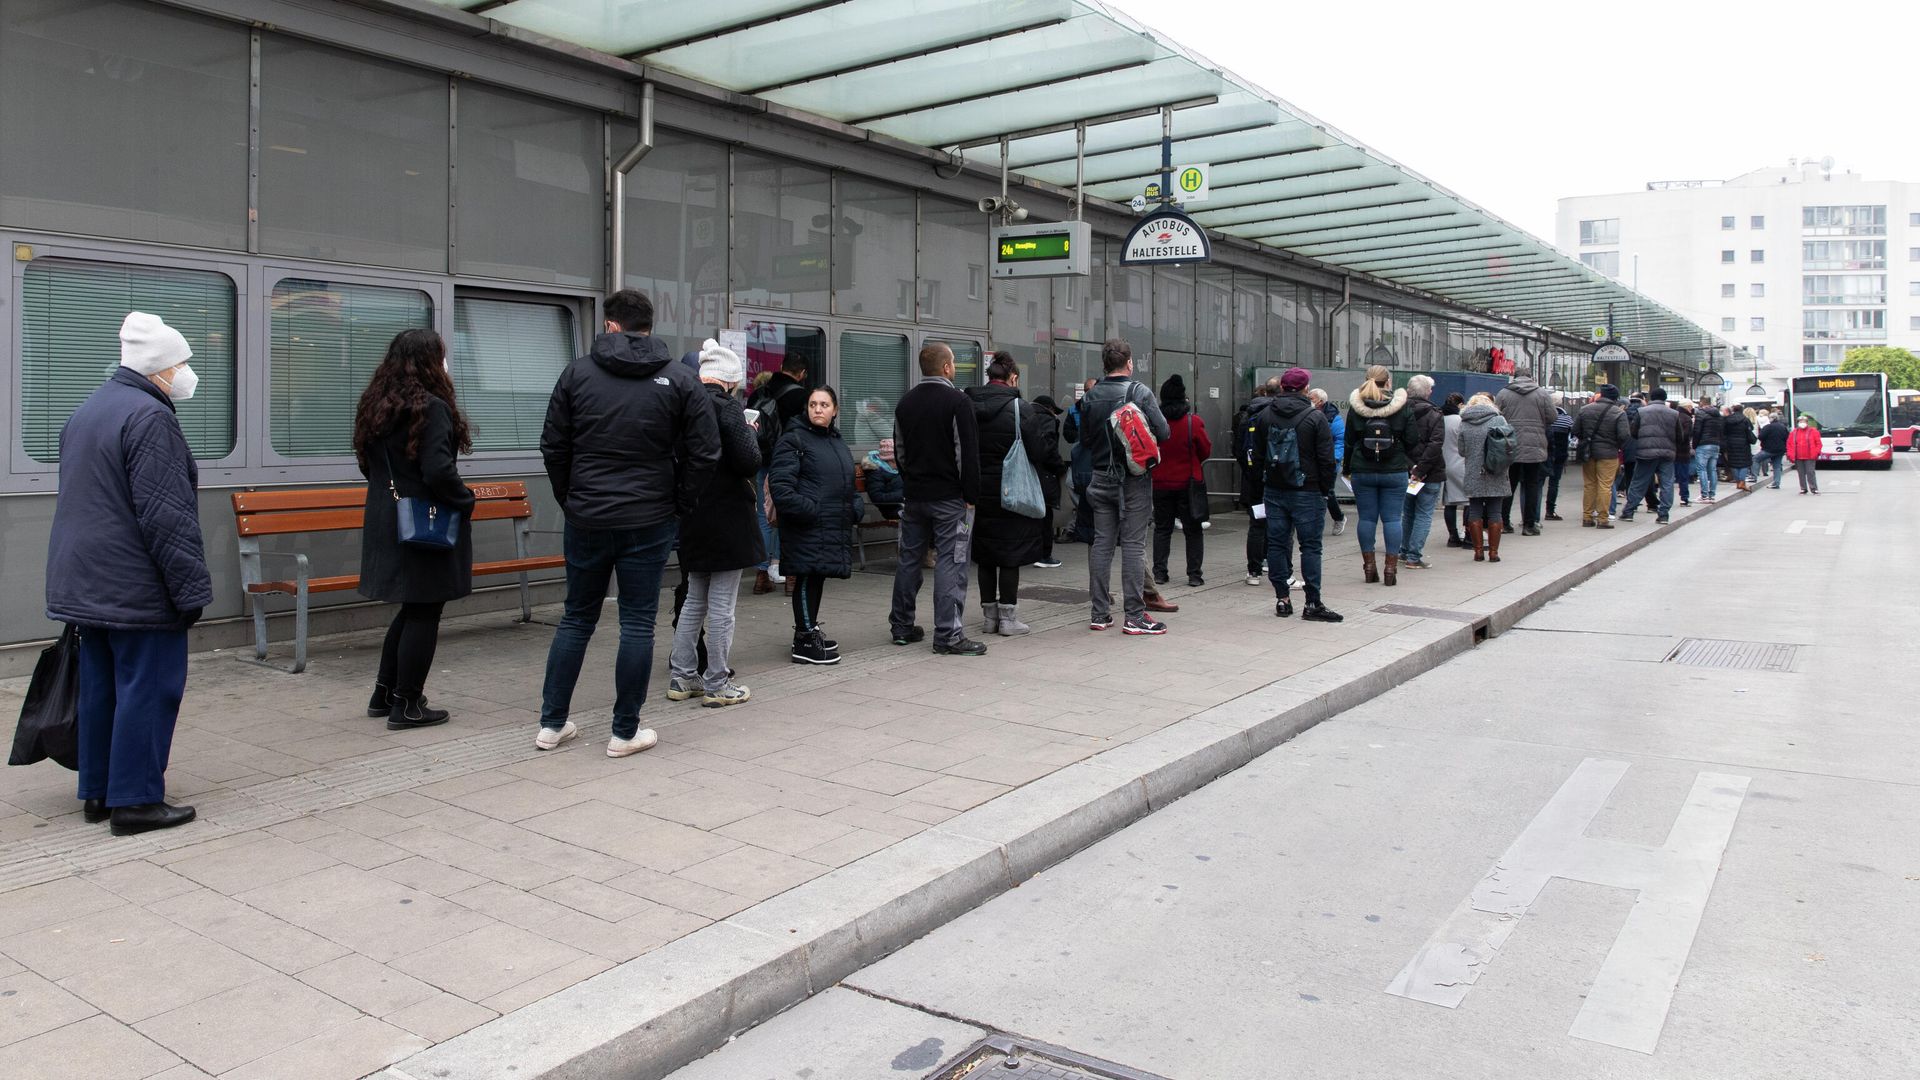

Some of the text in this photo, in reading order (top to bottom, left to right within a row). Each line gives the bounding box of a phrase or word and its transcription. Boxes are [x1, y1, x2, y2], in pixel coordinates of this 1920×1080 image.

[1185, 172, 1197, 188] H
[1142, 219, 1190, 238] AUTOBUS
[1063, 240, 1069, 252] 8
[1132, 245, 1197, 258] HALTESTELLE
[1818, 378, 1856, 389] Impfbus
